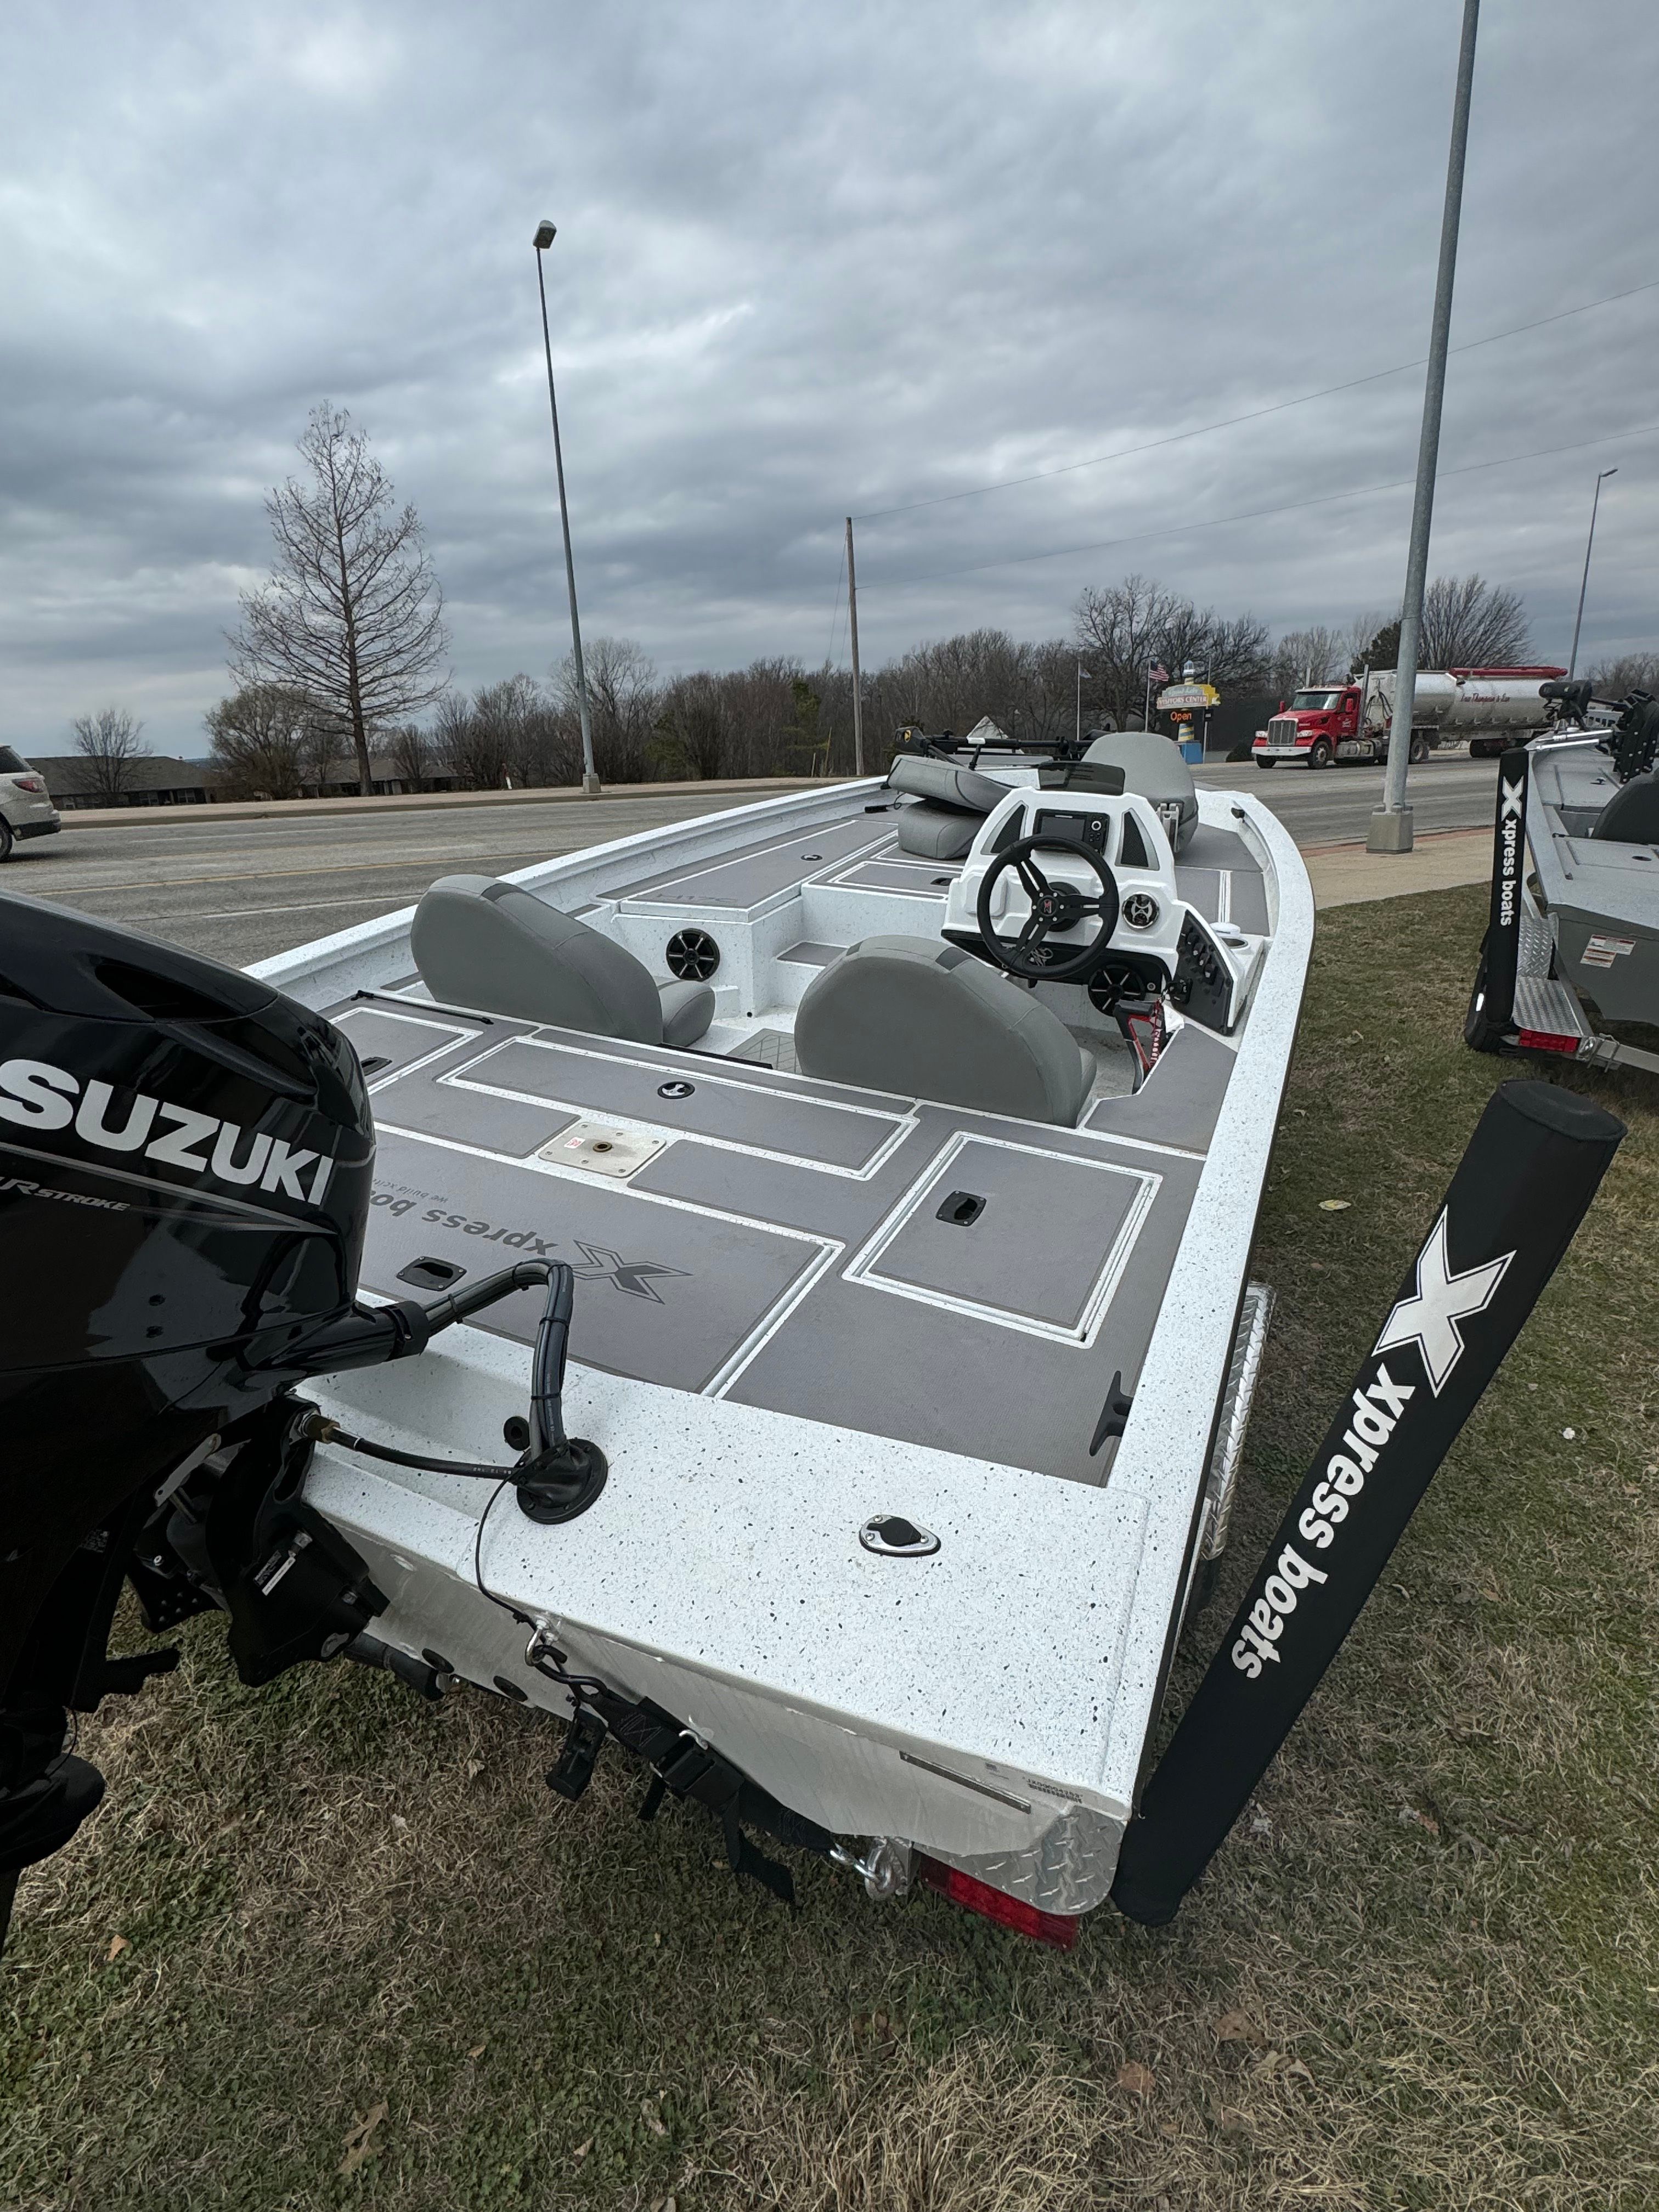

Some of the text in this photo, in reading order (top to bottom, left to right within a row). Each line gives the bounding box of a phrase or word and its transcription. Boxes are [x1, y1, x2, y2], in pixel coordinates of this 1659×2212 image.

[1170, 711, 1192, 723] Open
[1502, 819, 1517, 877] xpress
[1500, 880, 1517, 927] boats
[0, 1059, 334, 1206] SUZUKI
[370, 1190, 417, 1217] bo
[396, 1186, 430, 1199] build
[431, 1195, 448, 1203] we
[421, 1209, 558, 1256] xpress
[1297, 1363, 1416, 1550] xpress
[1231, 1542, 1328, 1679] boats
